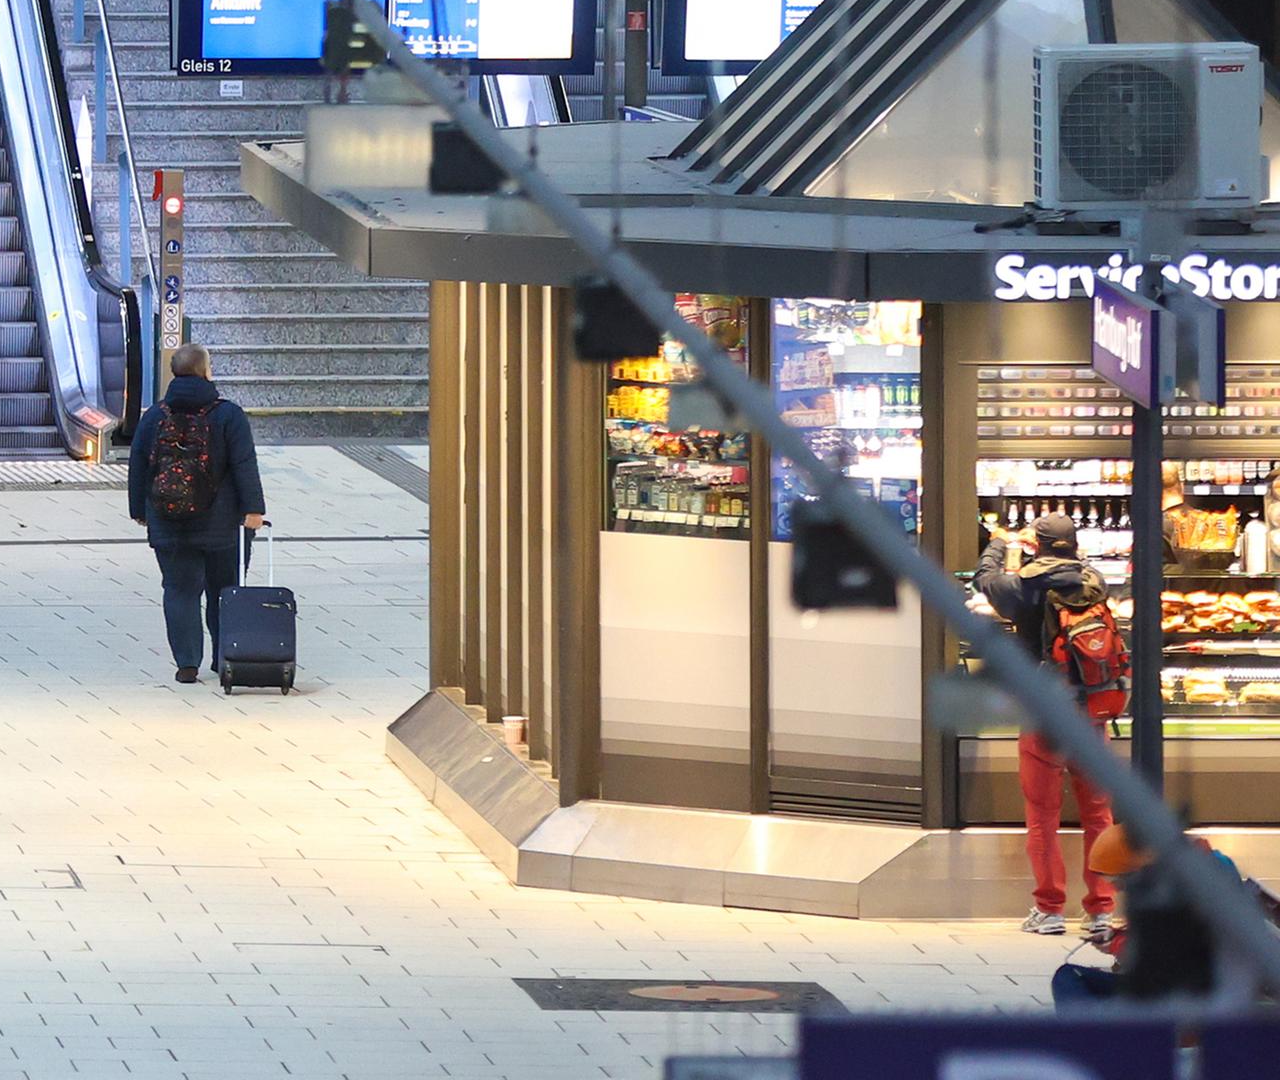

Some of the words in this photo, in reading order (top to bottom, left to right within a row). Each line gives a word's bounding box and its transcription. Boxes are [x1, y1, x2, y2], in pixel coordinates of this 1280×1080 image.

[181, 58, 216, 72] Gleis
[218, 58, 232, 72] 12
[1208, 63, 1246, 74] TOSOT
